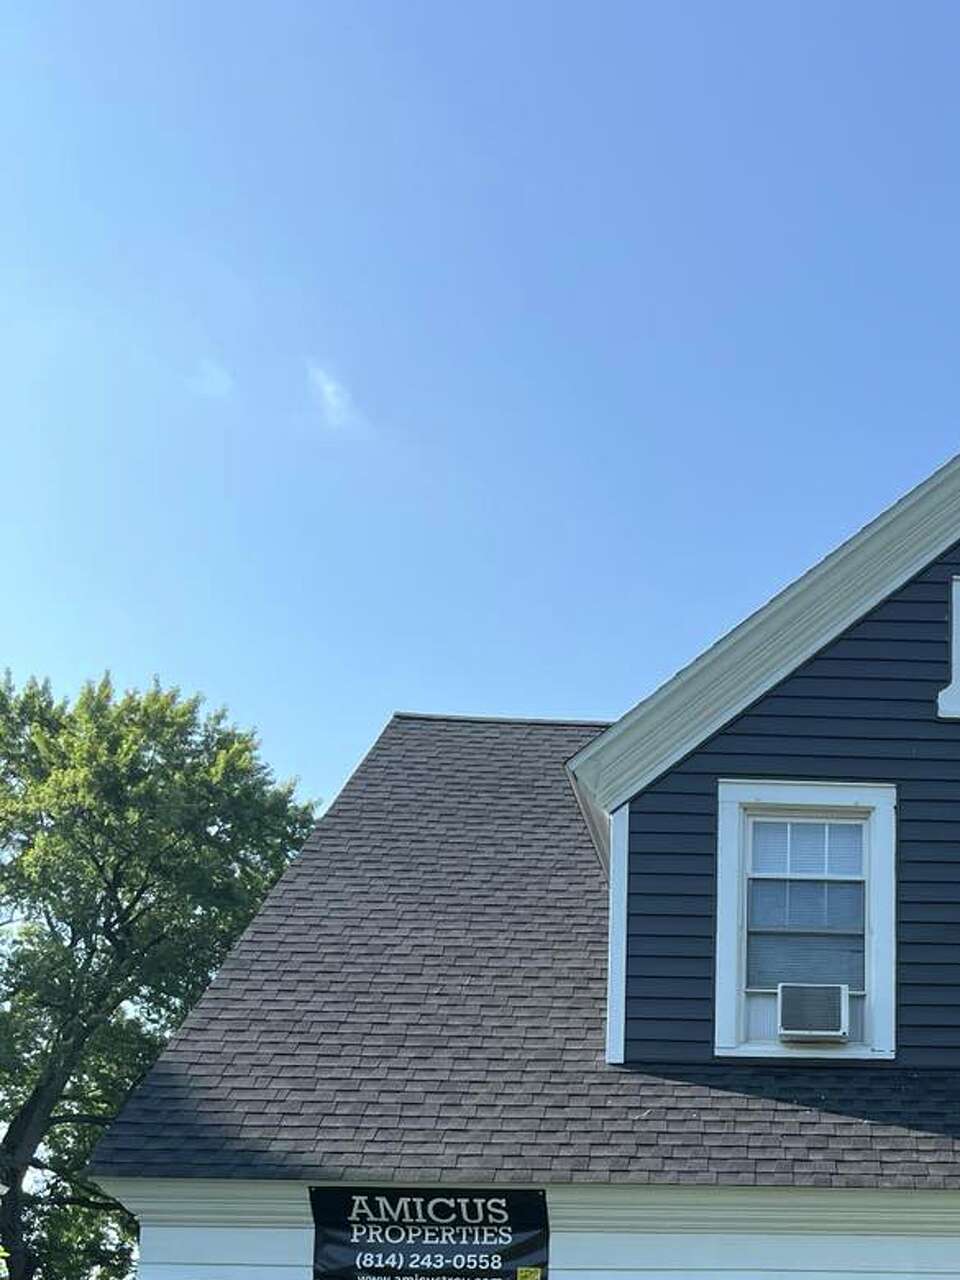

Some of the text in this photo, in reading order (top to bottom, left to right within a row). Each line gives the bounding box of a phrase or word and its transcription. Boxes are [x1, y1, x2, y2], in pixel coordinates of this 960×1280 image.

[347, 1195, 509, 1223] AMICUS
[350, 1225, 512, 1245] PROPERTIES
[356, 1252, 502, 1269] (814) 243-0558
